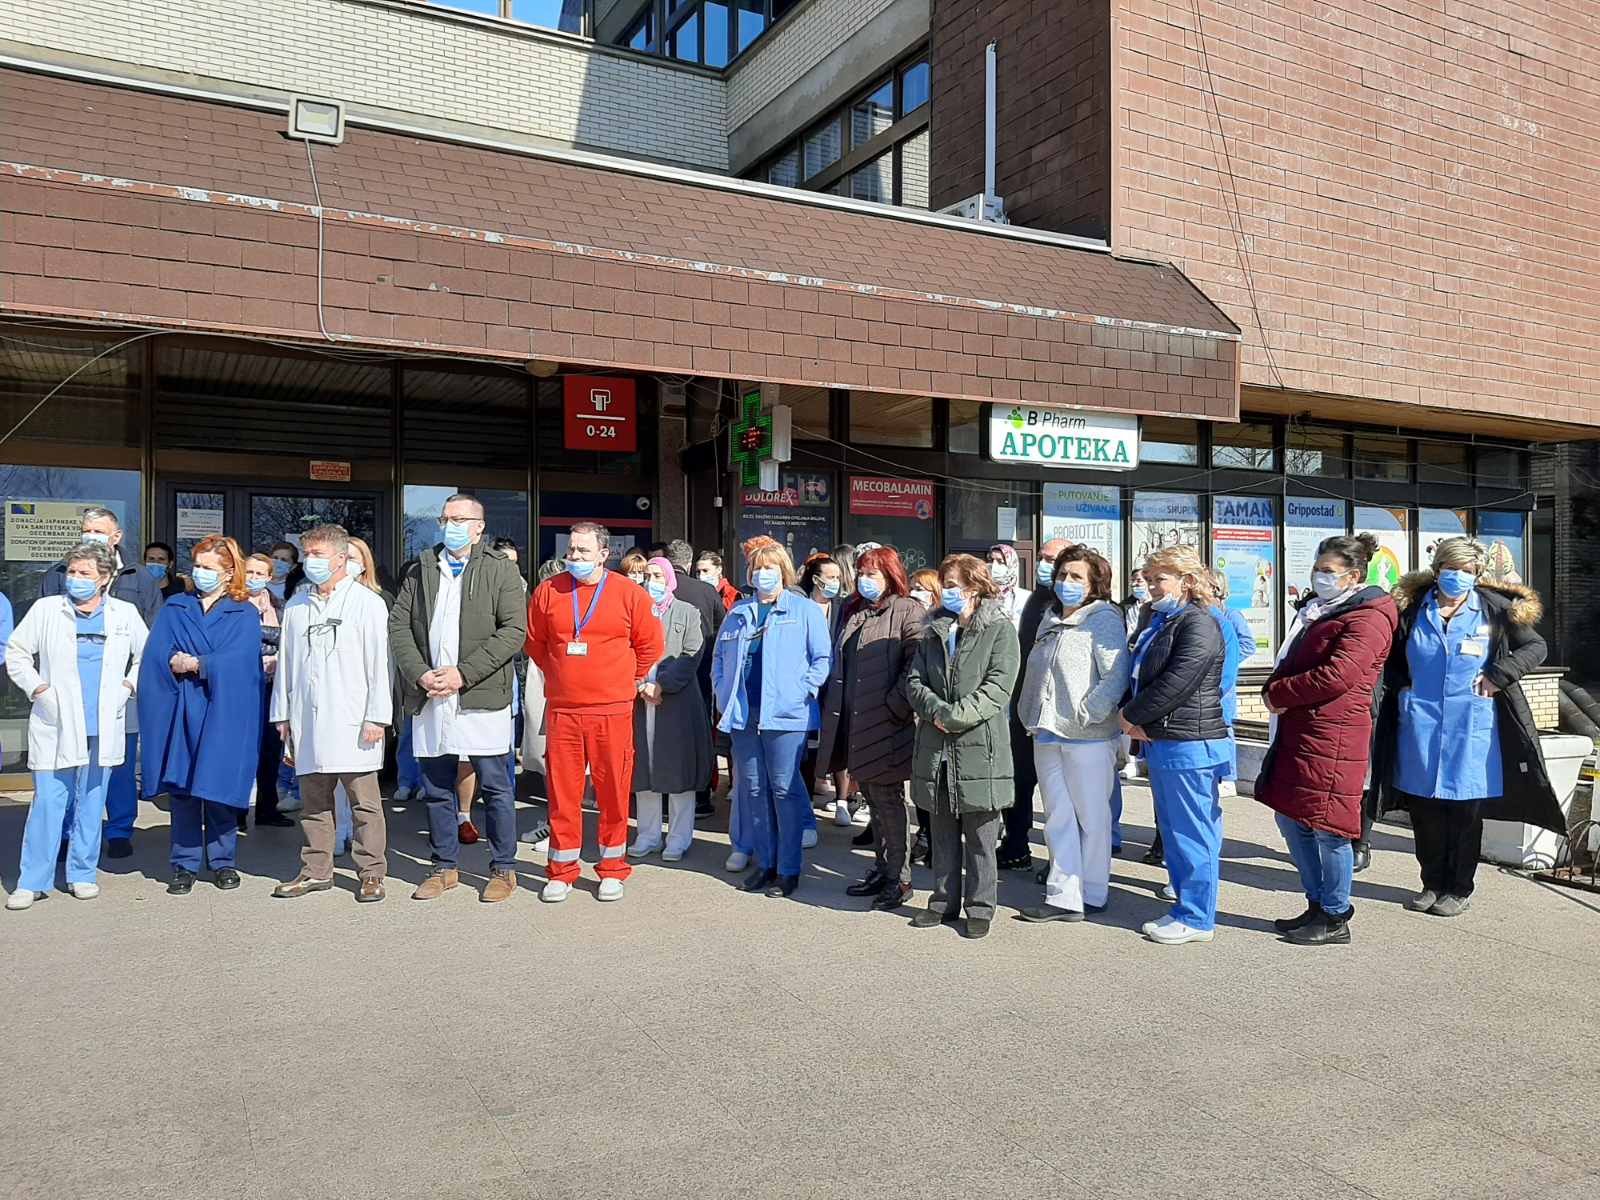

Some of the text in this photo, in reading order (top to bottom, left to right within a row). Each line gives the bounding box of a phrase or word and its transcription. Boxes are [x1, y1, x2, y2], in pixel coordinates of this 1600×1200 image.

[1027, 410, 1086, 429] B Pharm
[586, 424, 616, 438] 0-24
[1000, 431, 1130, 463] APOTEKA
[852, 479, 932, 495] MECOBALAMIN
[1215, 500, 1273, 518] TAMAN
[1288, 502, 1335, 518] Grippostad
[1053, 523, 1104, 540] PROBIOTIC
